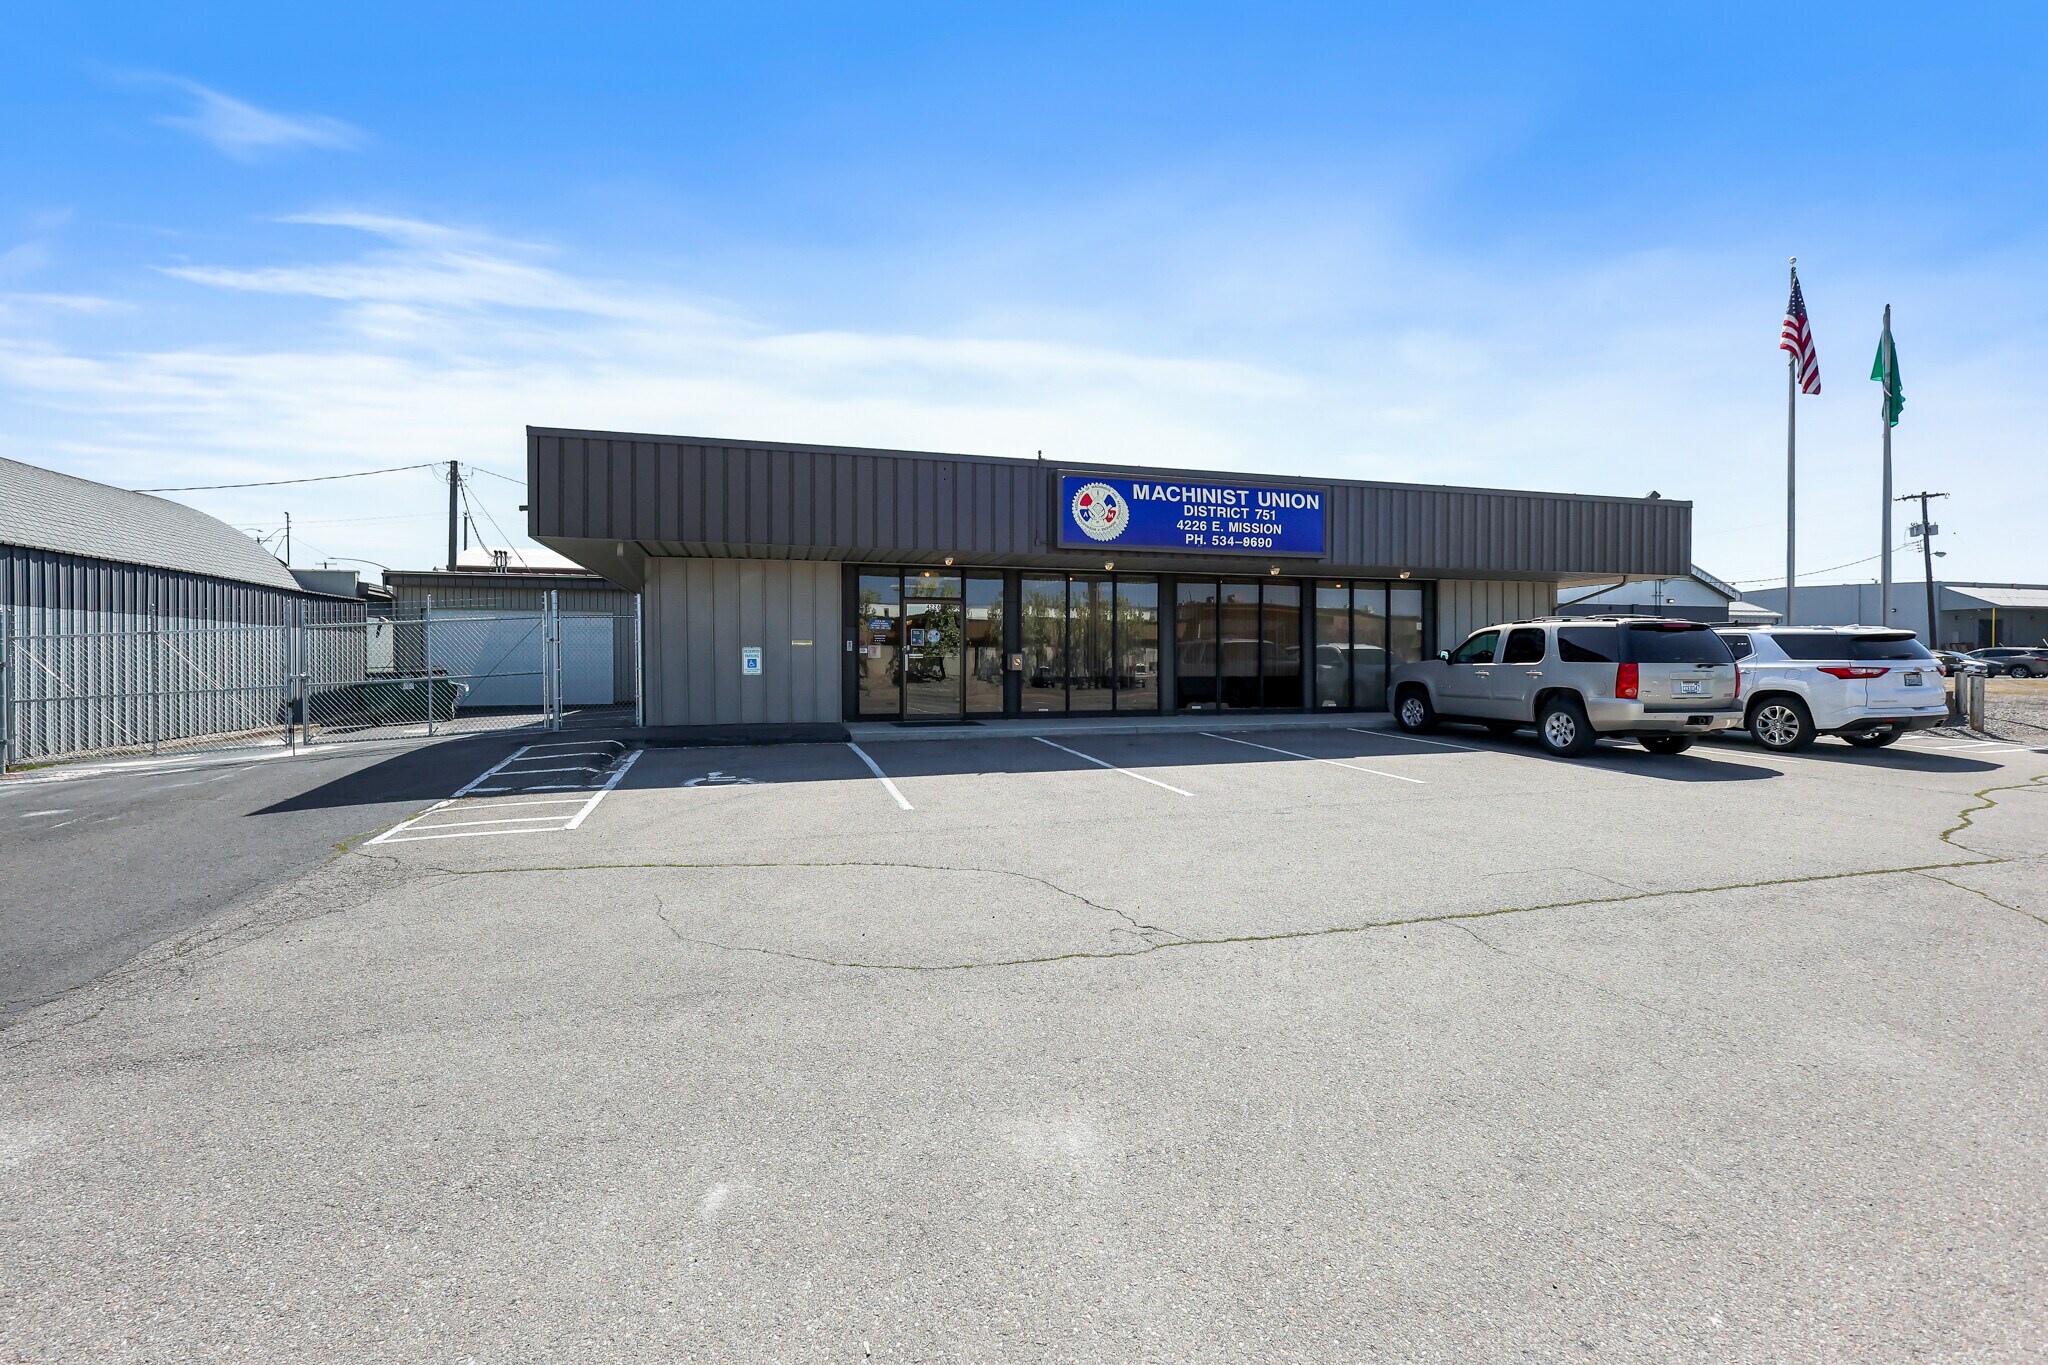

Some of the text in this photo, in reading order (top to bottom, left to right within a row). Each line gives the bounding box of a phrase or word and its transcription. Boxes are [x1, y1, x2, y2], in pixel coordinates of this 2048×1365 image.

[1133, 484, 1319, 510] MACHINIST UNION
[1184, 505, 1276, 520] DISTRICT 751
[1176, 520, 1282, 534] 4226 E. MISSION
[1185, 534, 1272, 548] PH. 534-9690
